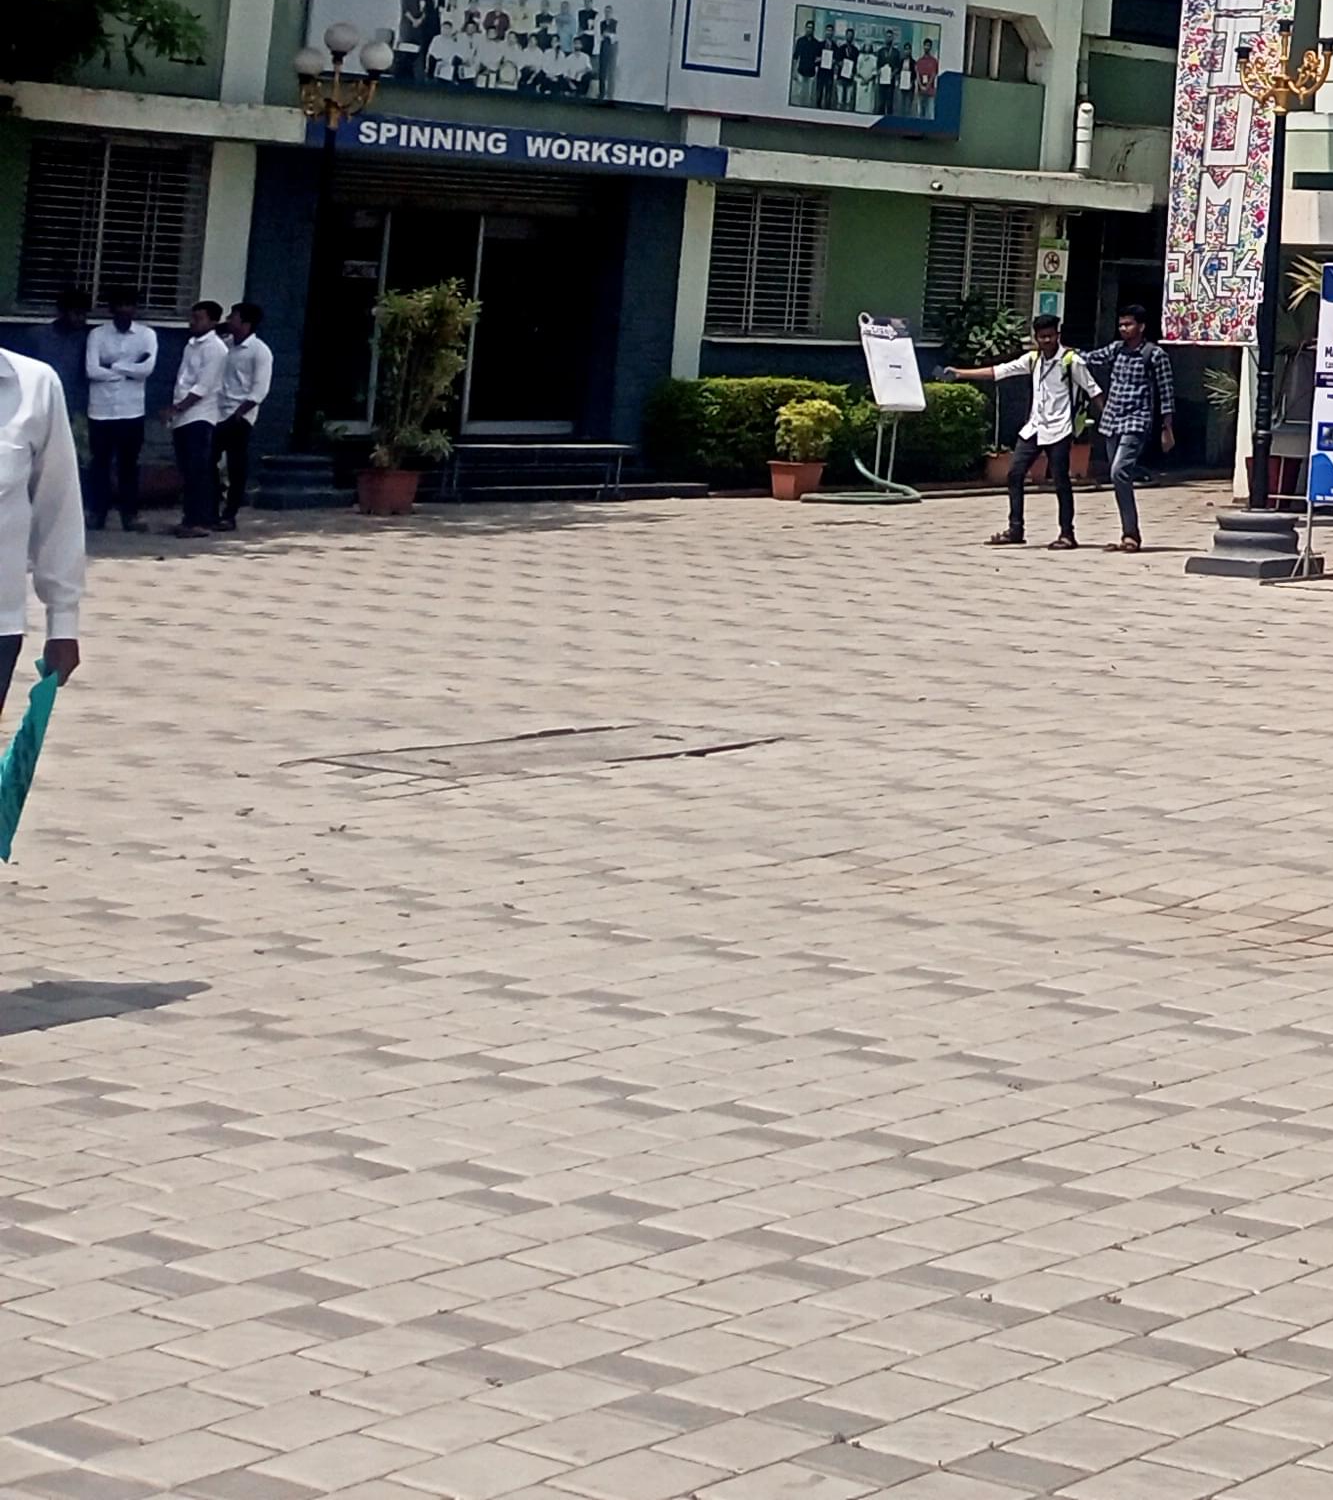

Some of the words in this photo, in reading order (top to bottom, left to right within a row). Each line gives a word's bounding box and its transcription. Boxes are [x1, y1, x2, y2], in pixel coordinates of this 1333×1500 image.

[359, 121, 507, 153] SPINNING
[526, 135, 685, 169] WORKSHOP
[1168, 250, 1262, 301] 2K24
